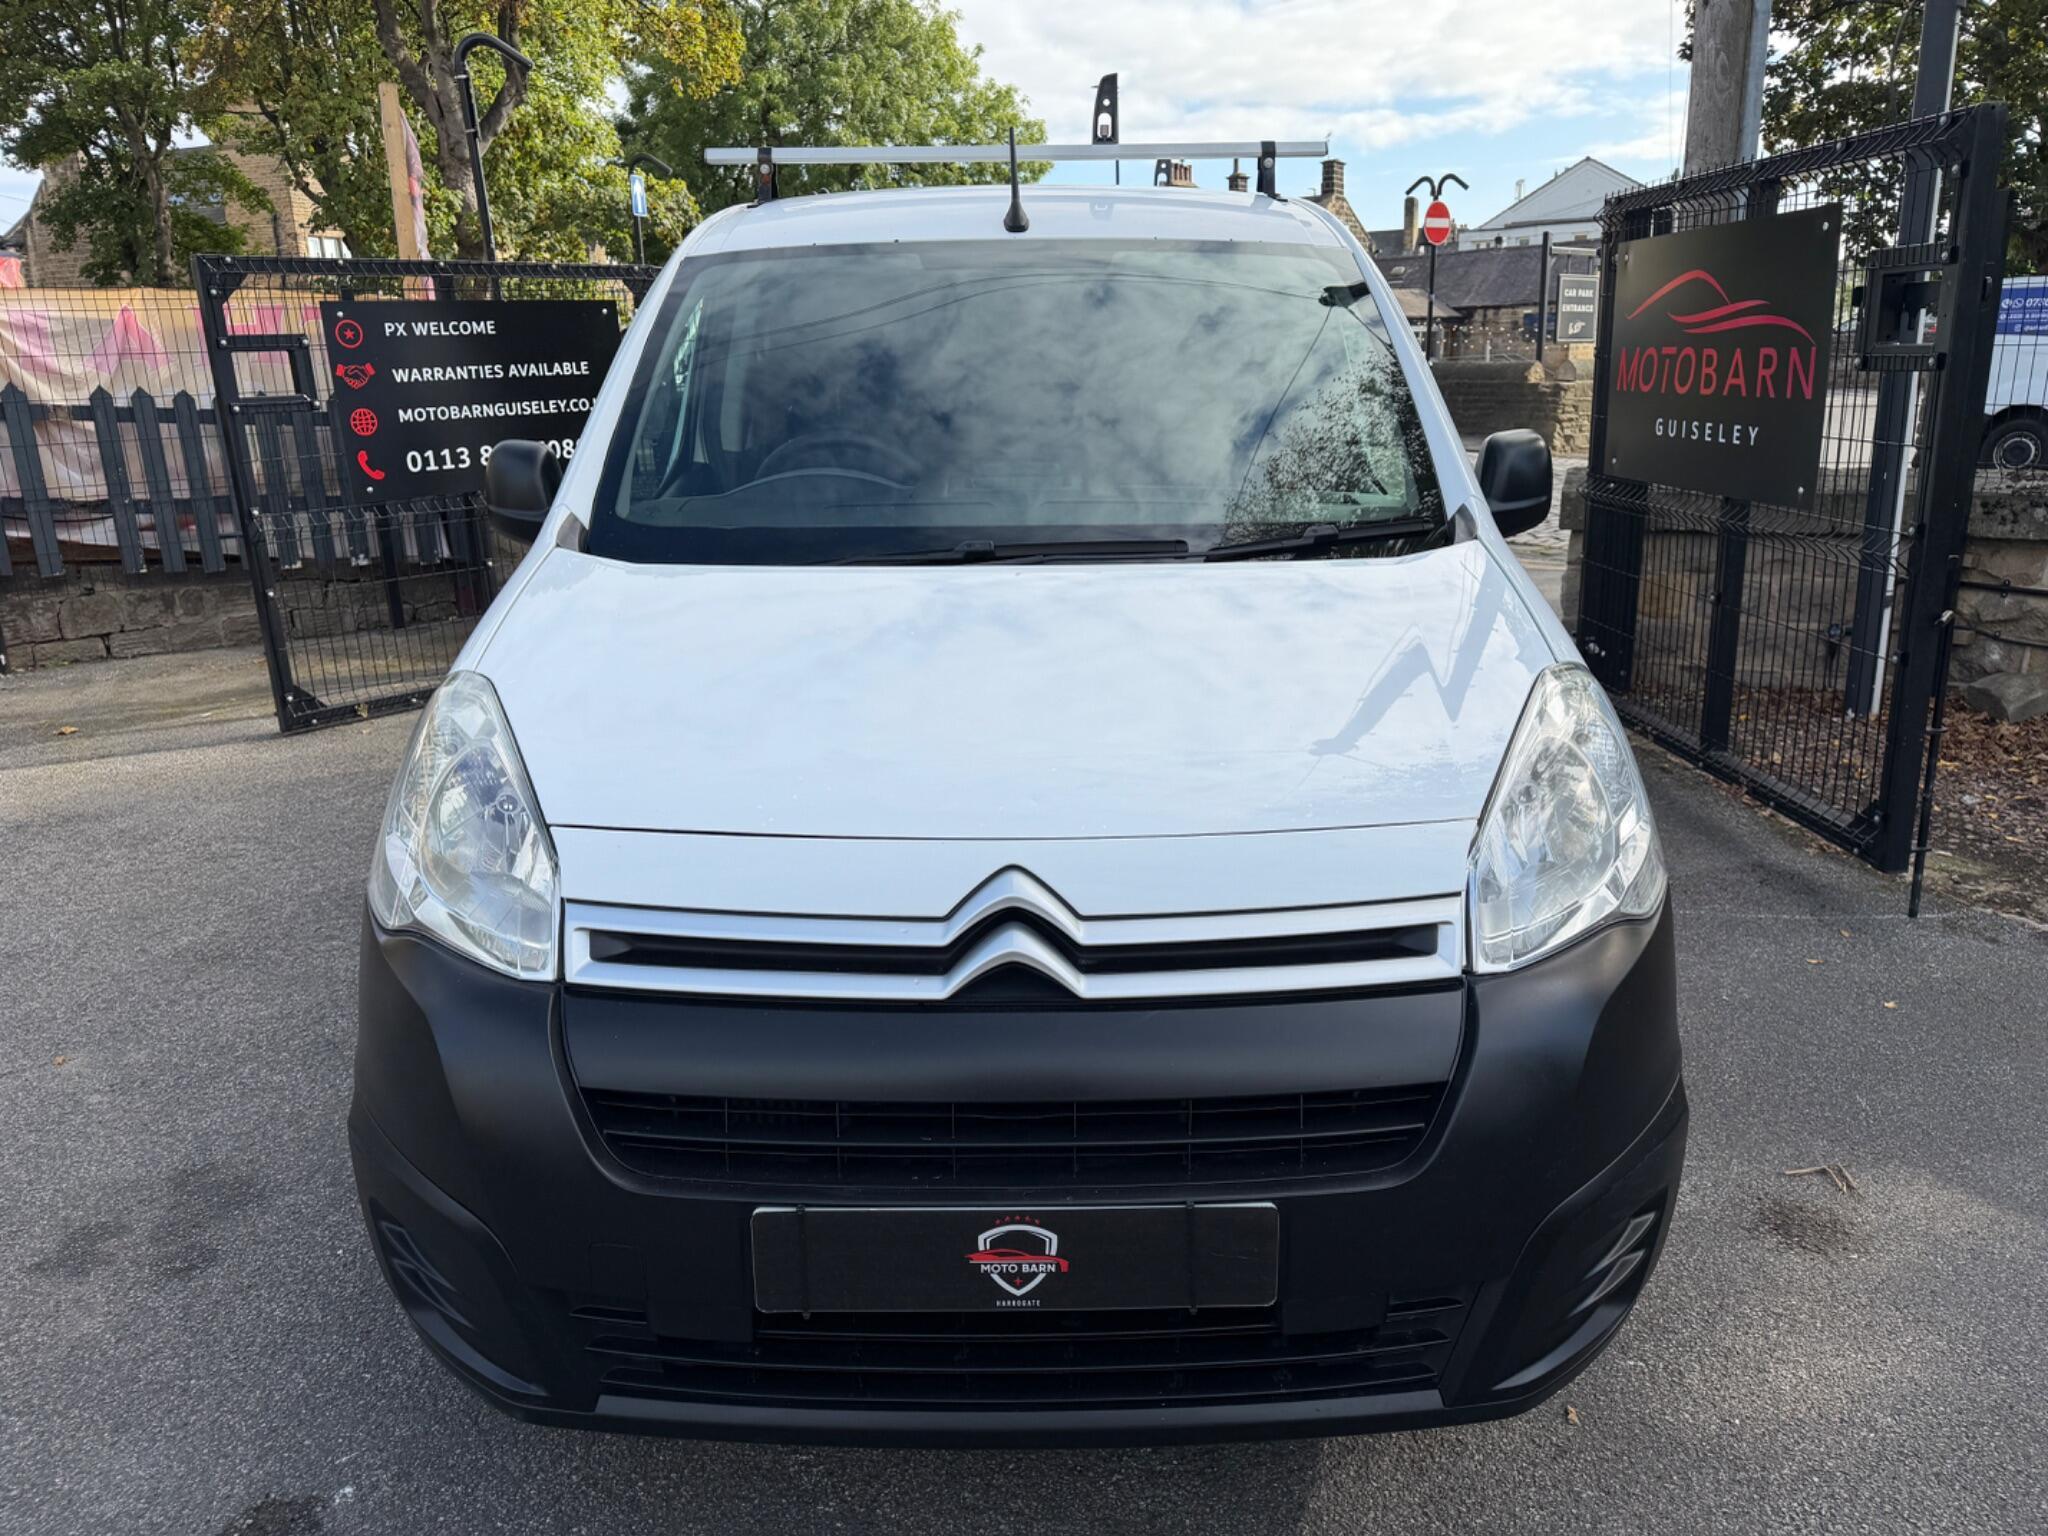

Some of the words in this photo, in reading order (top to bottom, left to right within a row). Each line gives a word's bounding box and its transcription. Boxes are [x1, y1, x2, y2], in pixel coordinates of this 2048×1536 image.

[1564, 288, 1577, 297] CAR
[1578, 288, 1594, 297] PARK
[1562, 303, 1594, 312] ENTRANCE
[384, 321, 407, 337] PX
[411, 319, 497, 337] WELCOME
[391, 363, 504, 384] WARRANTIES
[508, 360, 590, 379] AVAILABLE
[1616, 346, 1817, 400] MOTOBARN
[397, 397, 597, 423] MOTOBARNGUISELEY.CO.
[1655, 417, 1760, 447] GUISELEY
[406, 447, 471, 473] 0113
[980, 1263, 1018, 1274] MOTO
[1021, 1263, 1056, 1273] BARN
